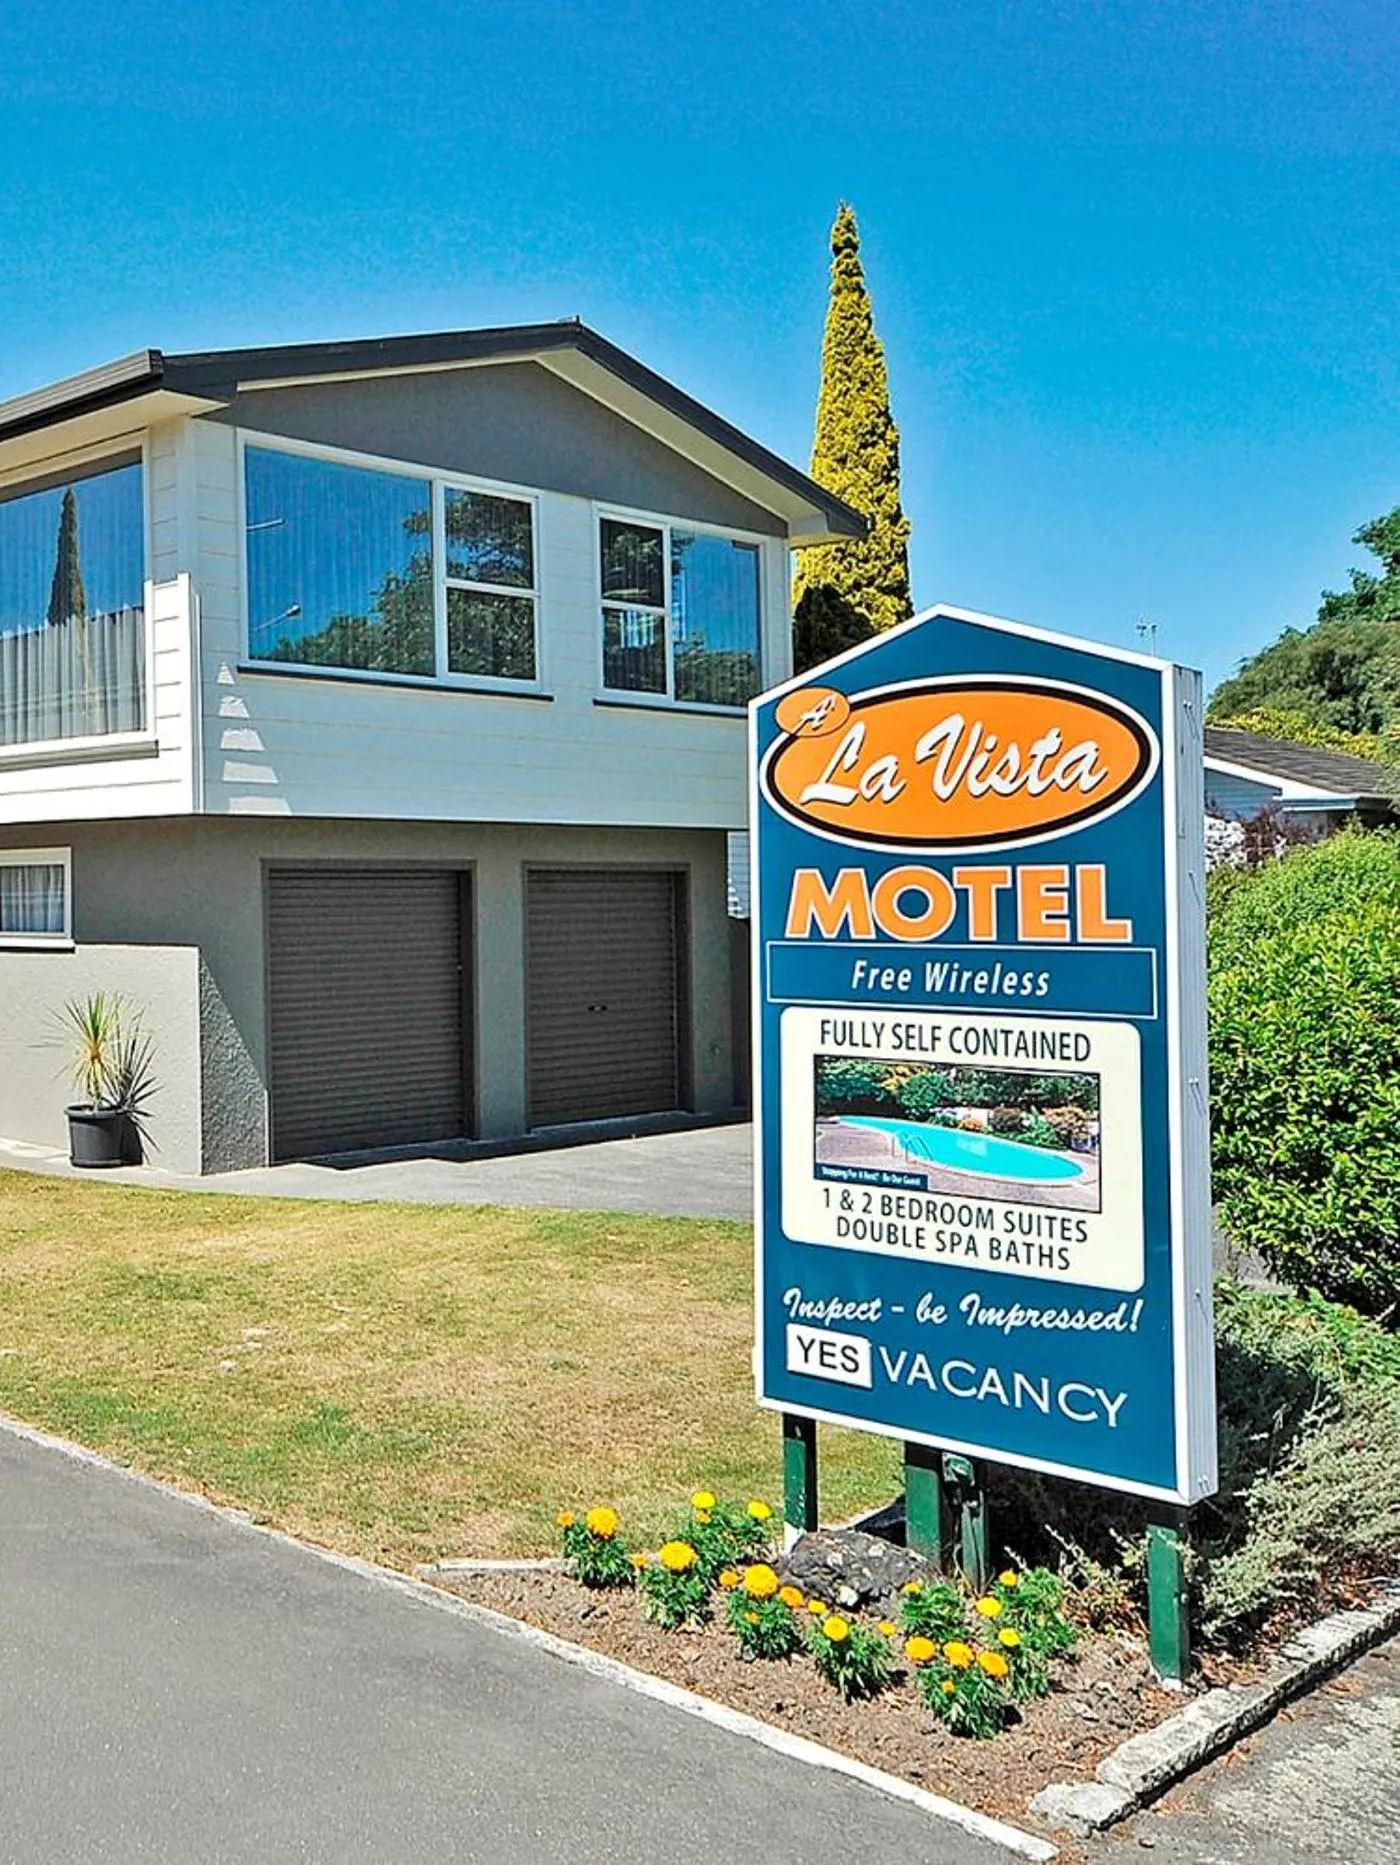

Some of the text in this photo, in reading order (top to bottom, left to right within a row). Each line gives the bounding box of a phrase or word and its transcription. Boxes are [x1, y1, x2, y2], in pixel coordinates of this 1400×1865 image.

[801, 713, 1109, 806] La Vista
[785, 864, 1134, 944] MOTEL
[851, 959, 1051, 998] Free Wireless
[819, 1019, 1092, 1062] FULLY SELF CONTAINED
[822, 1187, 1088, 1244] 1 & 2 BEDROOM SUITES
[837, 1216, 1071, 1271] DOUBLE SPA BATHS
[782, 1287, 883, 1327] Inspect
[916, 1292, 948, 1323] be
[958, 1293, 1145, 1335] Impressed!
[795, 1335, 1128, 1428] YES VACANCY
